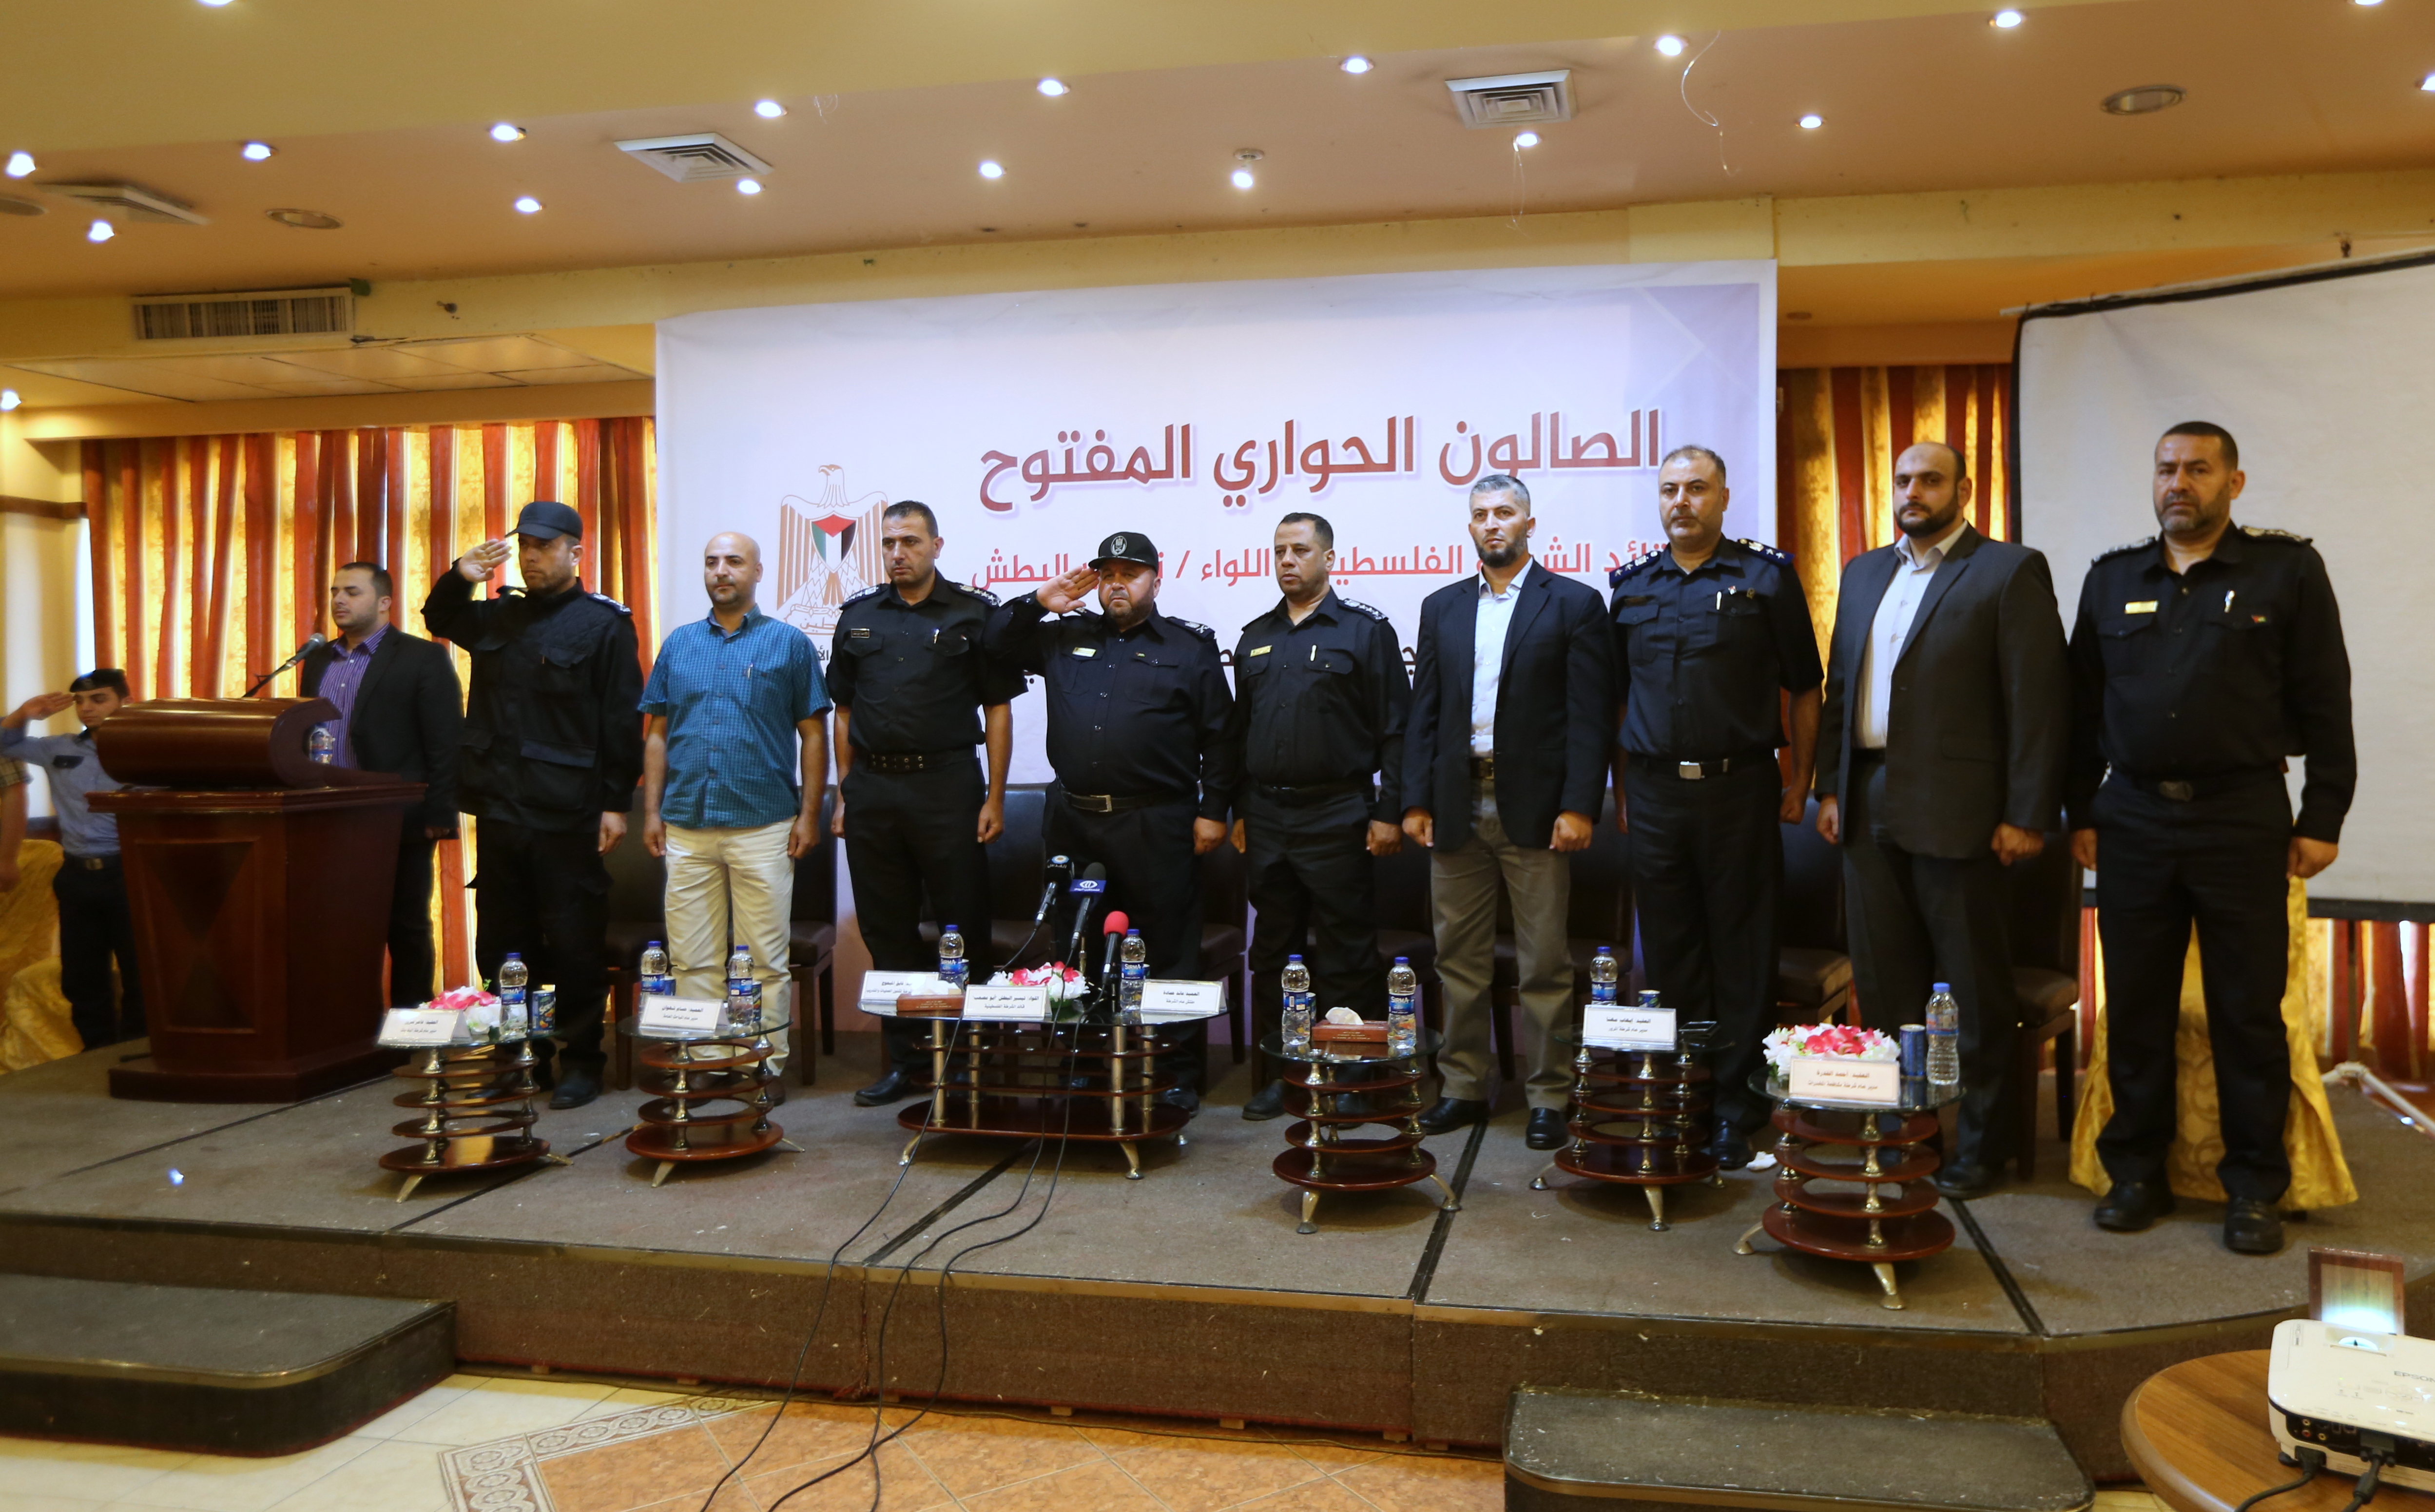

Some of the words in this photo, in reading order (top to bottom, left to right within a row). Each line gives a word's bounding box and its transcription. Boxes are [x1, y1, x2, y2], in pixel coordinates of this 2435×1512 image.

[980, 423, 1190, 511] المفتوح
[1214, 415, 1413, 507] الحواري
[1439, 409, 1658, 486] الصالون
[1201, 548, 1269, 586] اللواء
[1329, 544, 1463, 585] الفلسطي
[1604, 540, 1667, 572] ائد
[2394, 1371, 2435, 1383] EPSON
